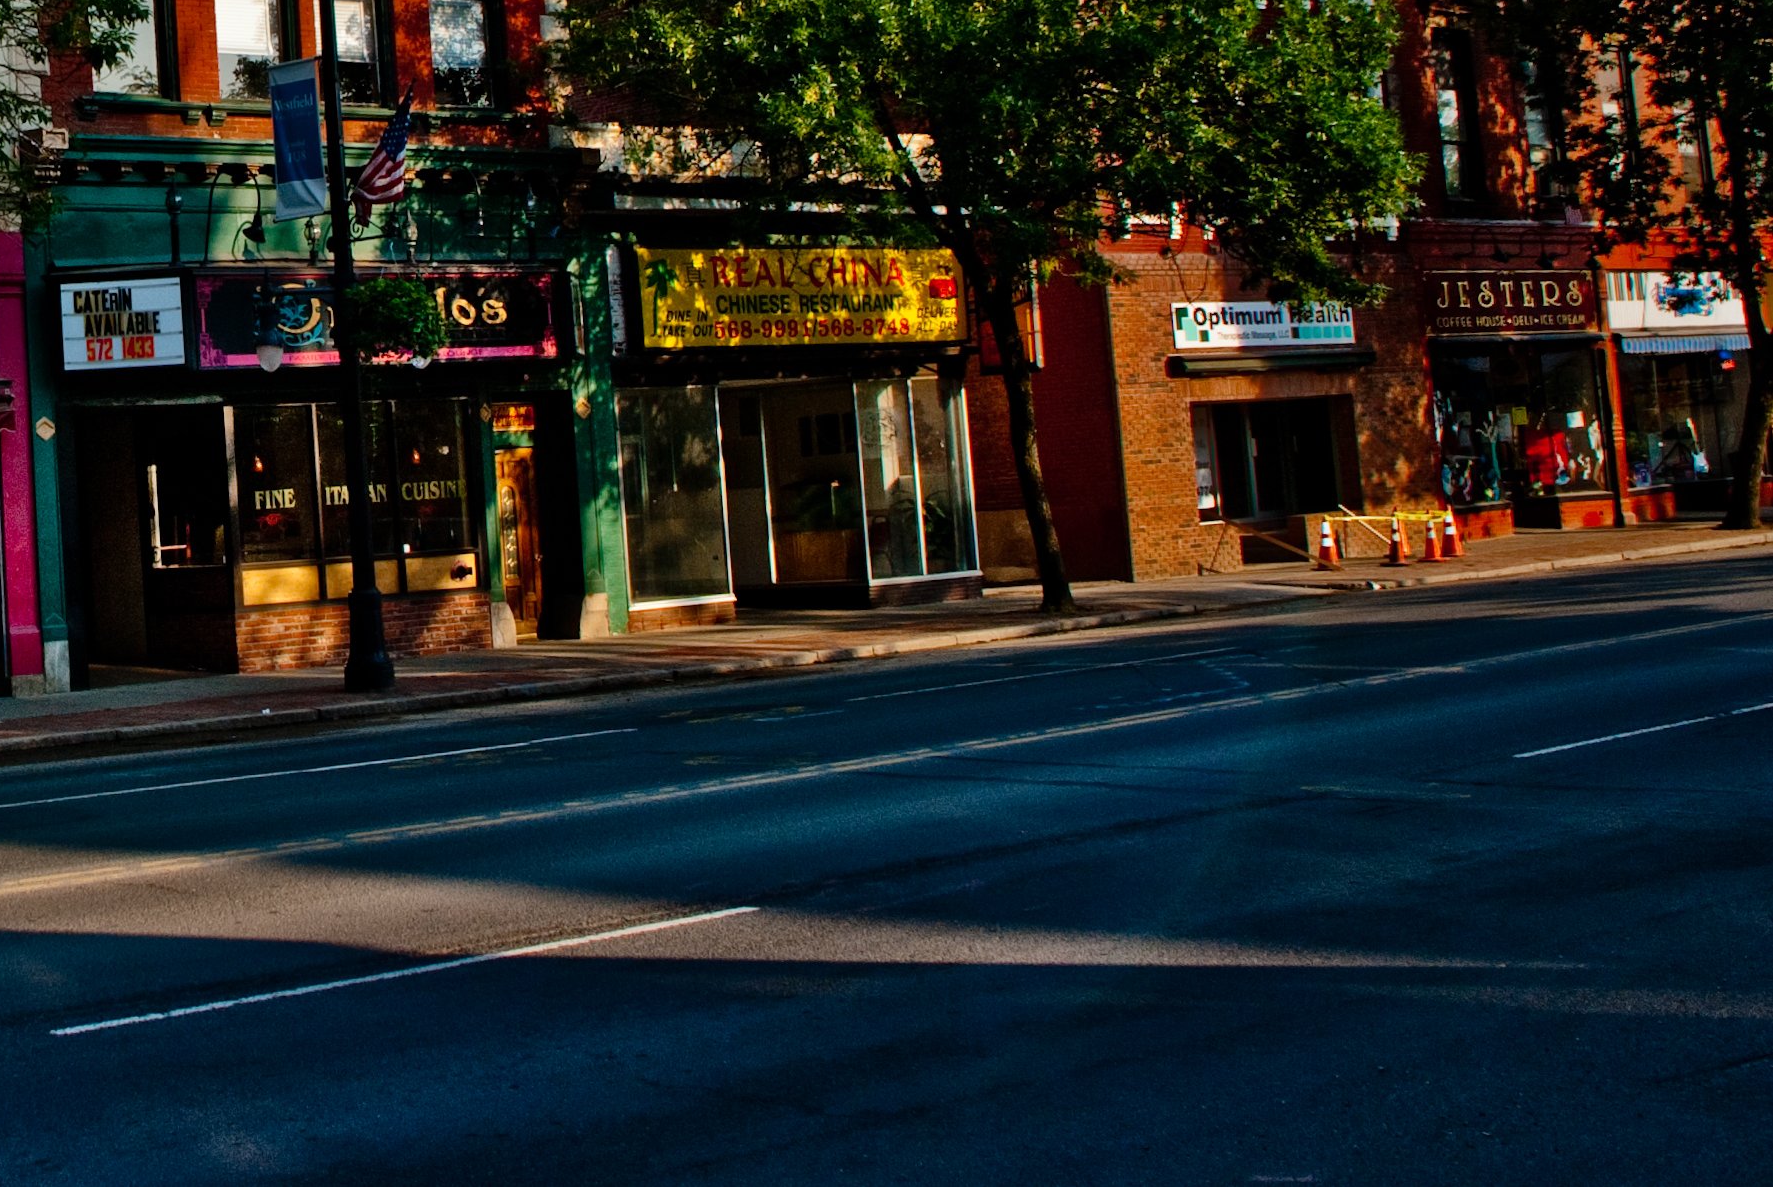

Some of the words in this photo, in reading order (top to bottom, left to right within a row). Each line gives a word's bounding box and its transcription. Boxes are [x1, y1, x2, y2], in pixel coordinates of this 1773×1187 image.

[710, 256, 794, 288] REAL
[808, 257, 906, 287] CHINA
[716, 294, 791, 315] CHINESE
[799, 293, 903, 314] RESTAURANT
[1436, 279, 1583, 309] JESTERS
[84, 311, 162, 338] AVAILABLE
[666, 310, 692, 323] DINE
[697, 310, 709, 322] IN
[1193, 306, 1283, 330] Optimum
[1436, 316, 1473, 329] COFFEE
[1476, 315, 1507, 328] HOUSE
[1513, 314, 1534, 327] DELI
[1540, 314, 1555, 326] ICE
[1557, 313, 1587, 326] CREAM
[663, 324, 687, 338] TAKE
[693, 324, 714, 337] OUT
[86, 337, 113, 362] 572
[122, 335, 155, 360] 1433
[255, 487, 297, 511] FINE
[325, 481, 388, 507] ITAAN
[401, 478, 468, 502] CUISINE
